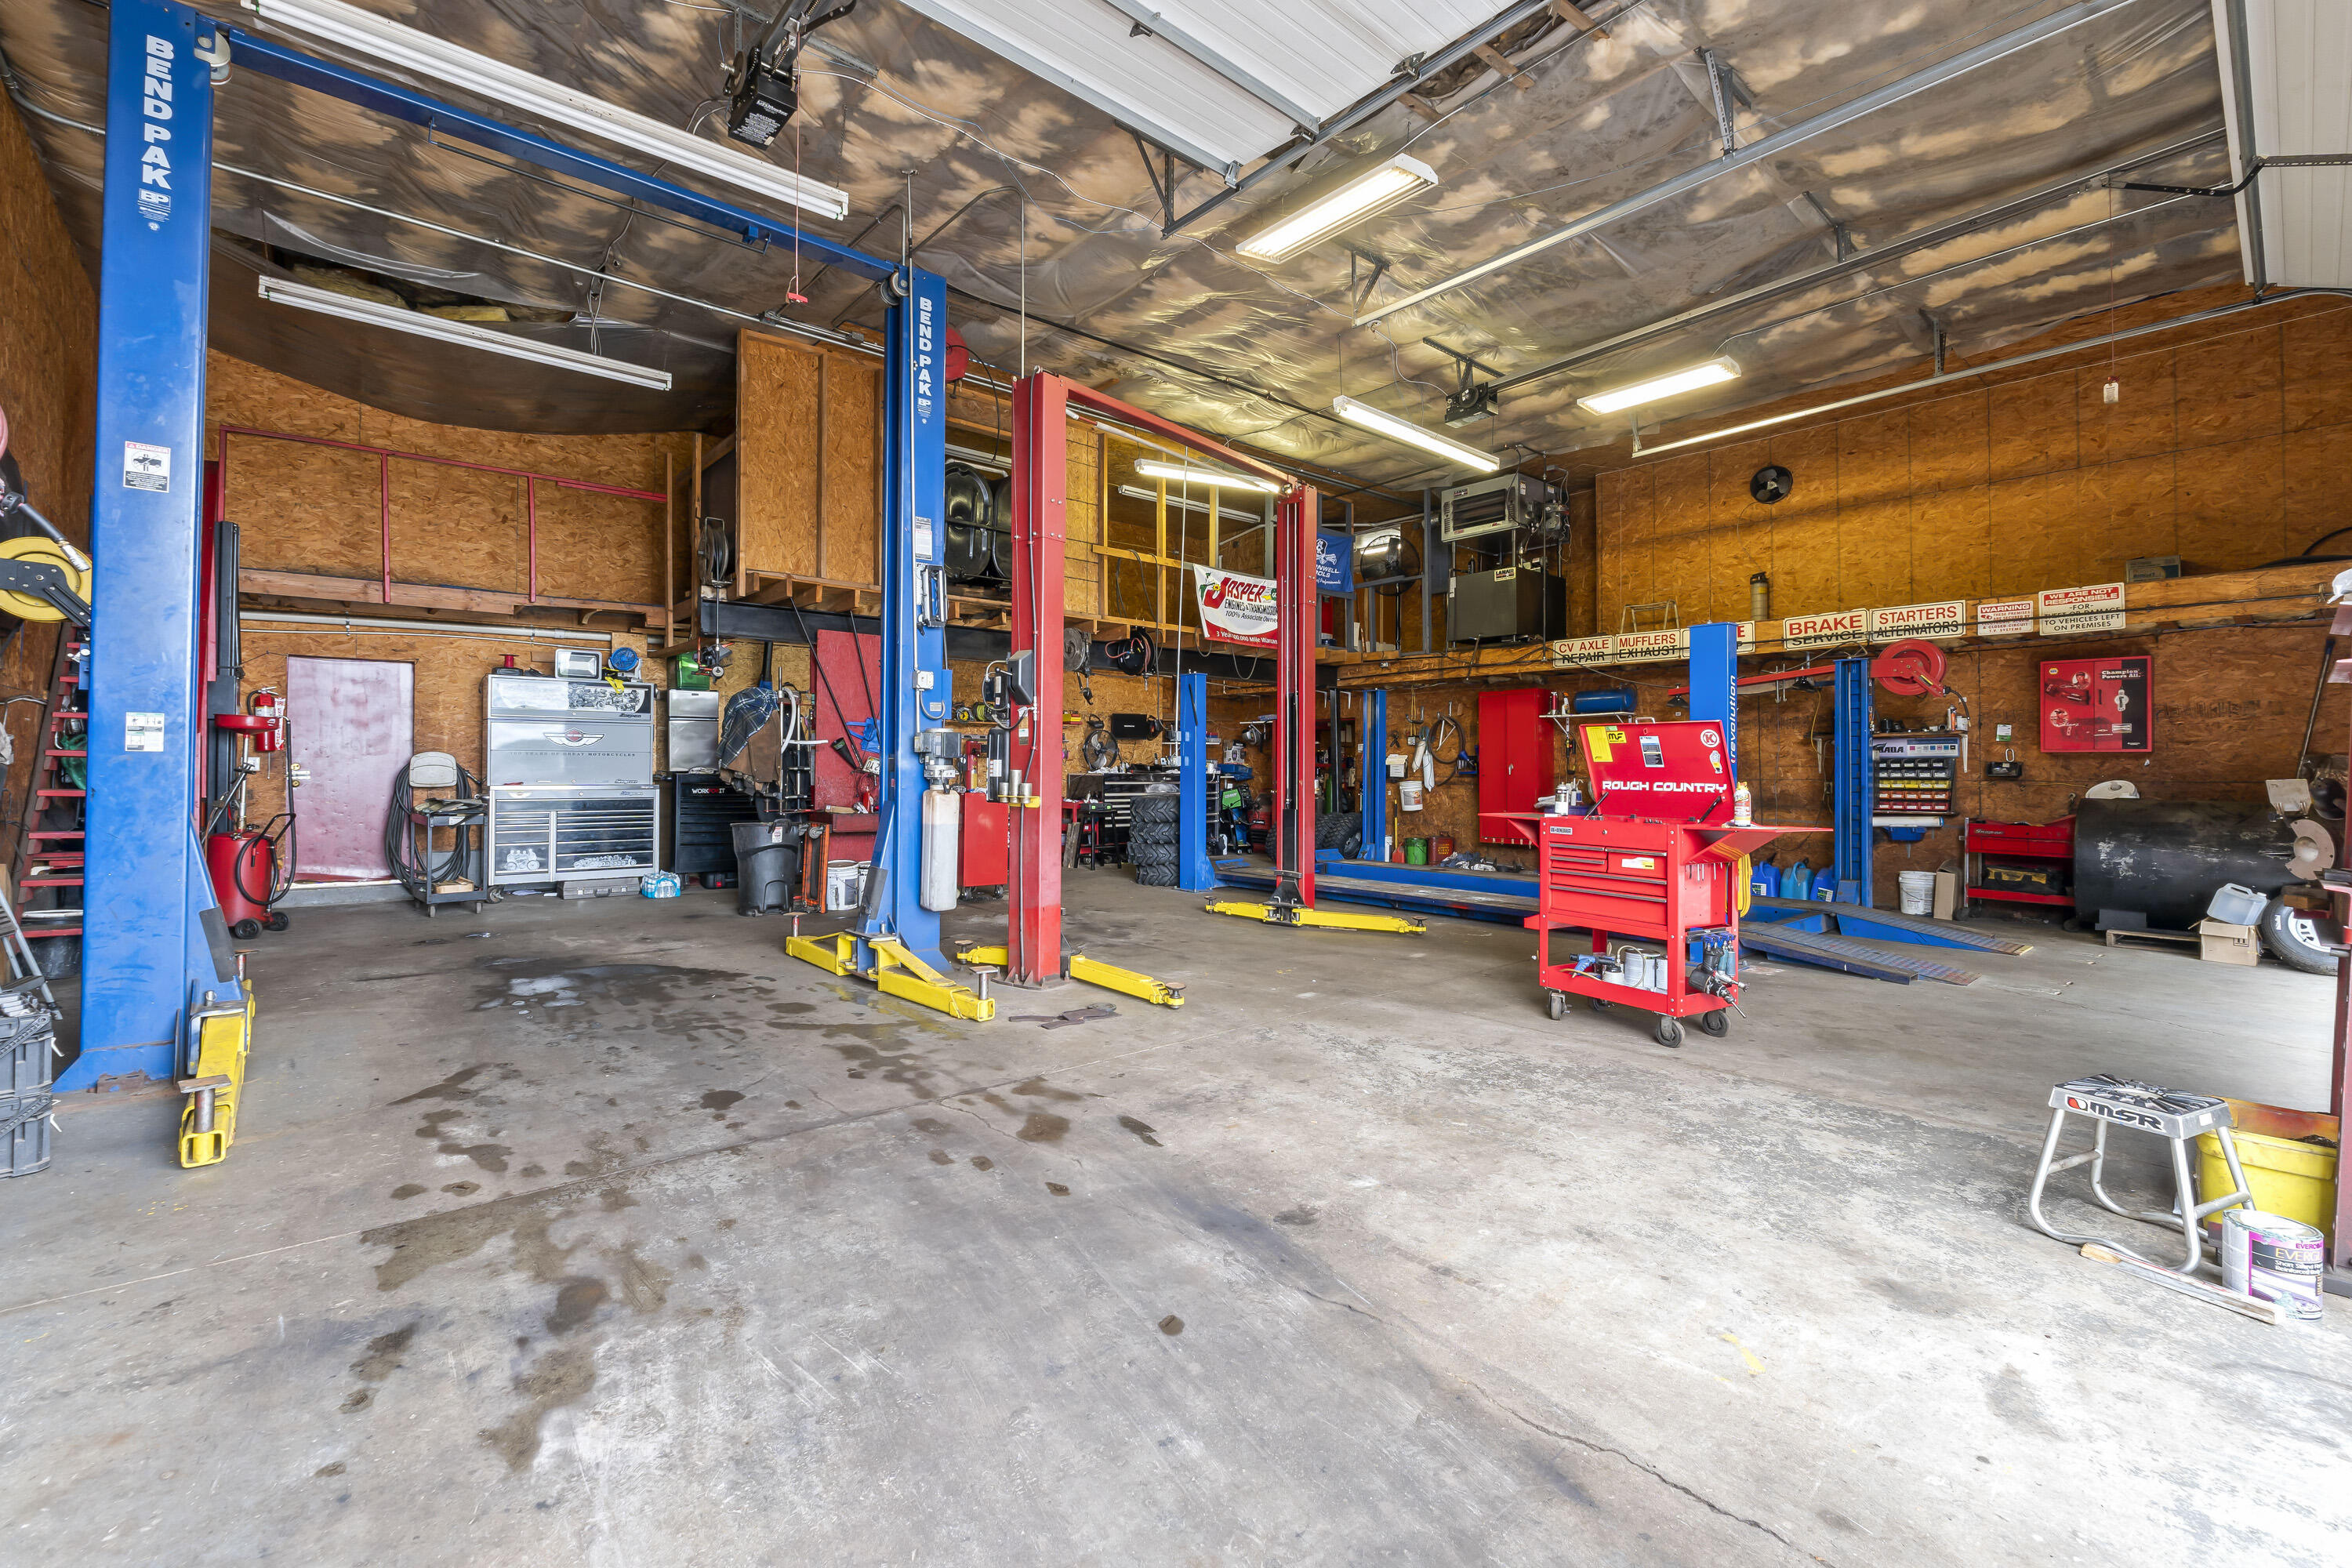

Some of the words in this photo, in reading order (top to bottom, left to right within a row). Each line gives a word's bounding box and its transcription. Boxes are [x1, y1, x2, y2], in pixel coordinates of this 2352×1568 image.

[1203, 577, 1266, 609] JASPER
[2045, 593, 2118, 605] RESPONSIBLE
[1224, 598, 1245, 612] ENGINES
[1981, 604, 2030, 613] WARNING
[1878, 606, 1958, 625] STARTERS
[2059, 615, 2099, 624] VEHICLES
[1789, 614, 1863, 636] BRAKE
[1876, 620, 1959, 638] ALTERNATORS
[2071, 621, 2111, 630] PREMISES
[1619, 633, 1676, 648] MUFFLERS
[1791, 629, 1863, 646] SERVICE
[1559, 643, 1573, 654] CV
[1579, 639, 1610, 652] AXLE
[1619, 644, 1678, 659] EXHAUST
[1562, 651, 1605, 664] REPAIR
[1602, 781, 1650, 791] ROUGH
[1653, 782, 1727, 793] COUNTRY
[2090, 1102, 2162, 1131] MSR
